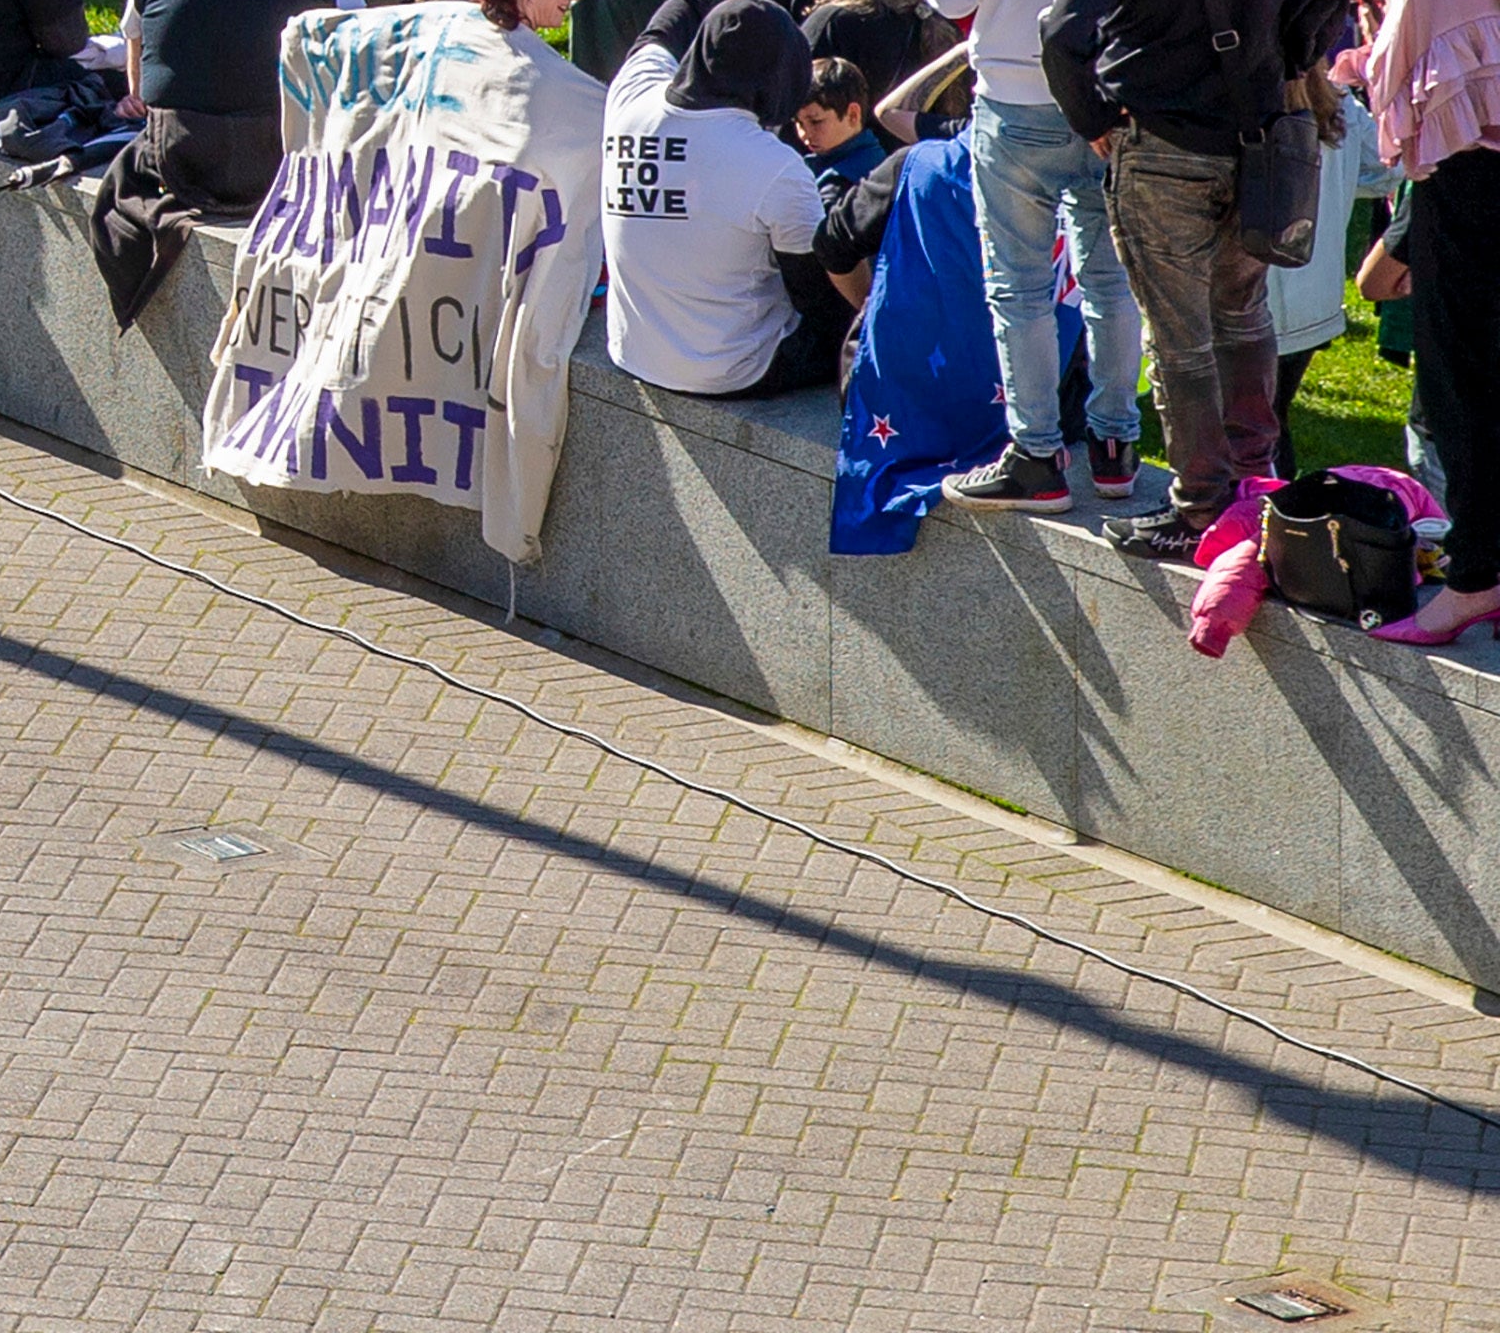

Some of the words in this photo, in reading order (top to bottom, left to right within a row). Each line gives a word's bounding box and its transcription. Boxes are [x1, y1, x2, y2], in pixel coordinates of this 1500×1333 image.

[605, 136, 688, 162] FREE
[617, 161, 659, 185] TO
[247, 145, 567, 276] HUMANITY
[605, 189, 687, 214] LIVE
